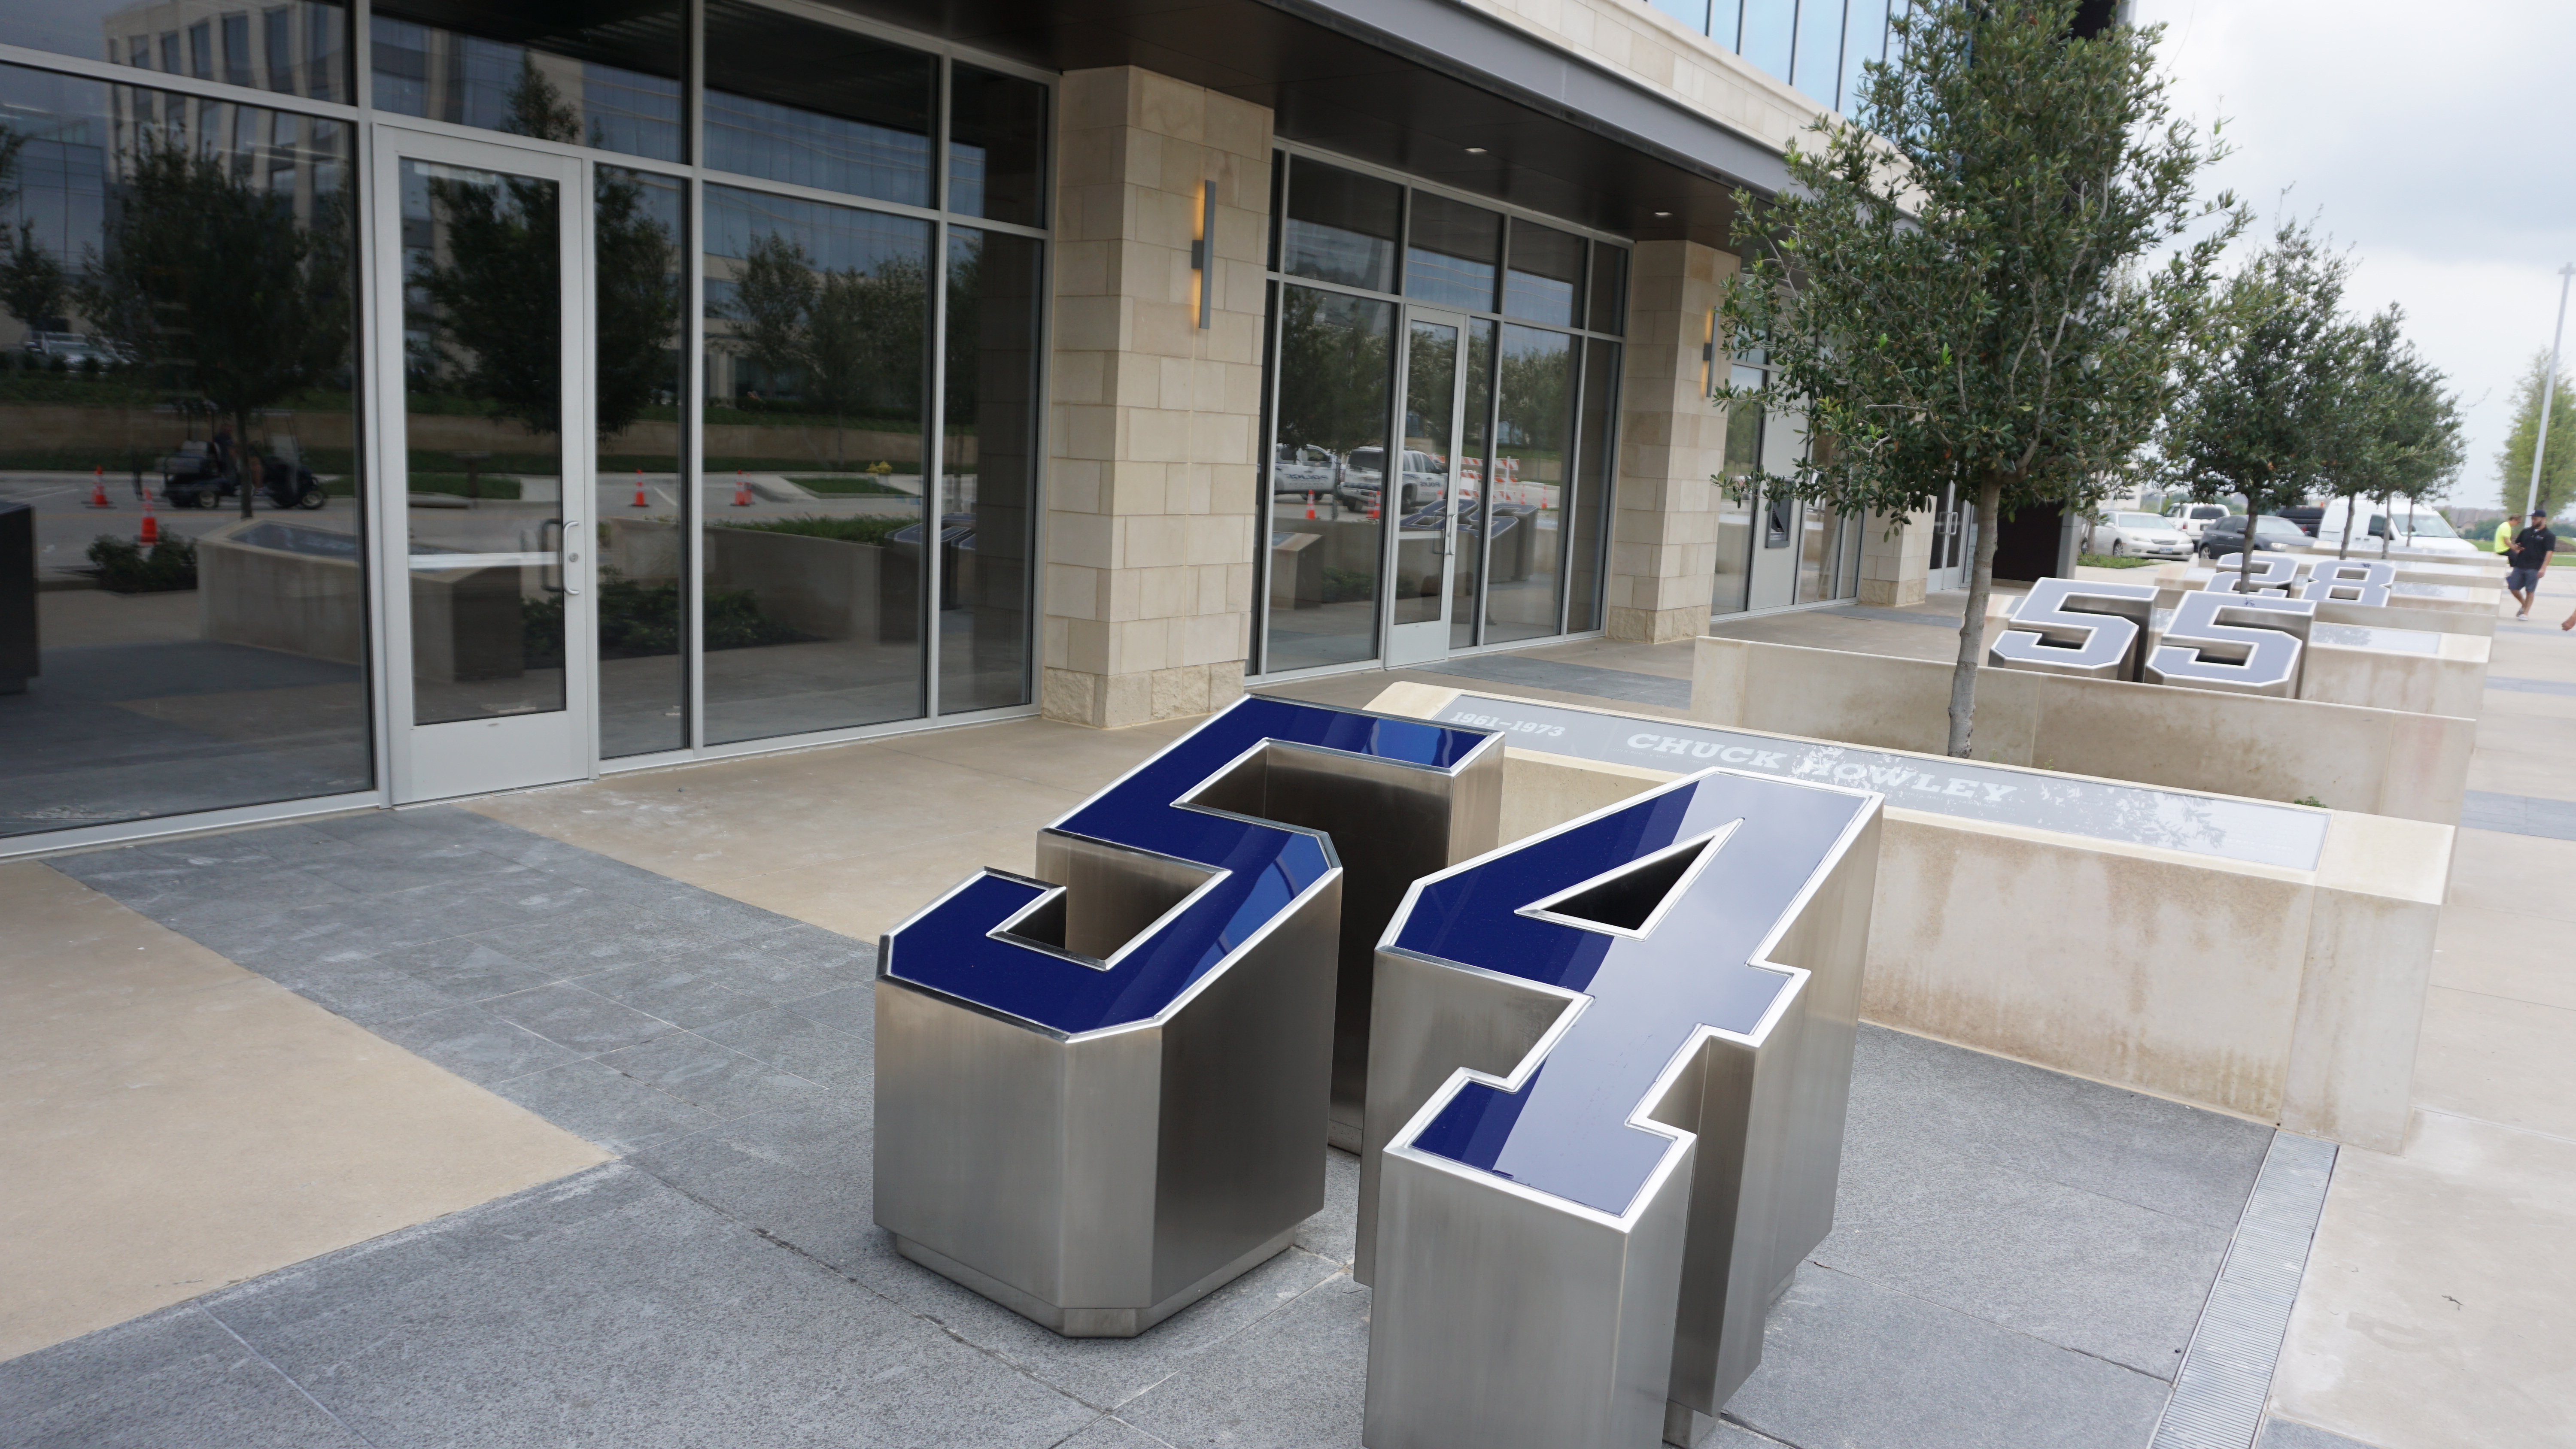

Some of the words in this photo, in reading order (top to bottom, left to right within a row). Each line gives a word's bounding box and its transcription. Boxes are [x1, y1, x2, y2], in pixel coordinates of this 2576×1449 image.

[2203, 552, 2396, 607] 28
[1991, 577, 2317, 687] 55
[1449, 712, 1566, 737] 1961-1973
[1627, 733, 1787, 769] CHUCK
[1793, 758, 2018, 802] HOWLEY
[878, 694, 1885, 1233] 54
